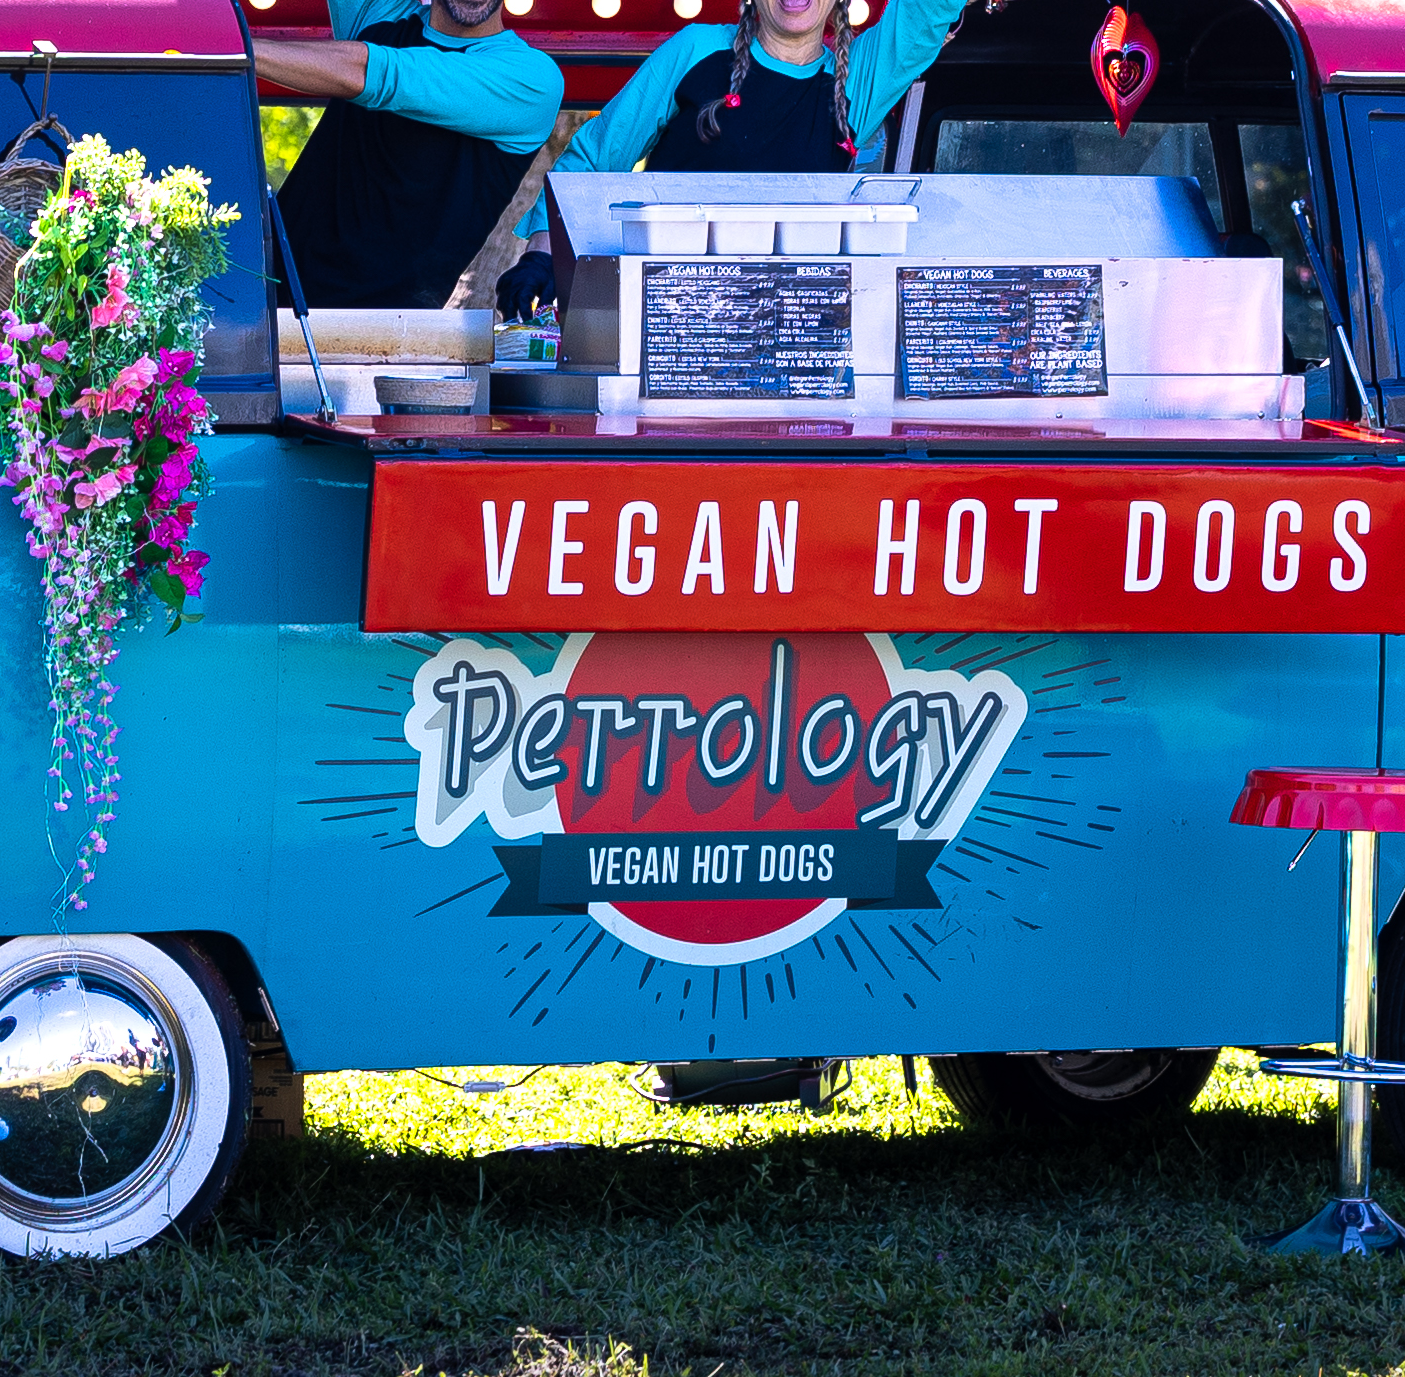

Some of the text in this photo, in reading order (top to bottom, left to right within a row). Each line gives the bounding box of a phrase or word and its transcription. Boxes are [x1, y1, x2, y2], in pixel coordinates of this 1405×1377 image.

[668, 266, 741, 276] VEGAN HOT DOGS
[796, 267, 831, 276] BEBIDAS
[924, 270, 994, 279] VEGAN HOT DOGS
[1043, 269, 1089, 278] BEVERAGES
[1030, 350, 1046, 360] OUR
[1030, 360, 1046, 369] ARE
[1076, 360, 1102, 369] BASED
[481, 498, 1371, 596] VEGAN HOT DOGS
[432, 636, 1005, 827] Perrology
[589, 844, 834, 885] VEGAN HOT DOGS
